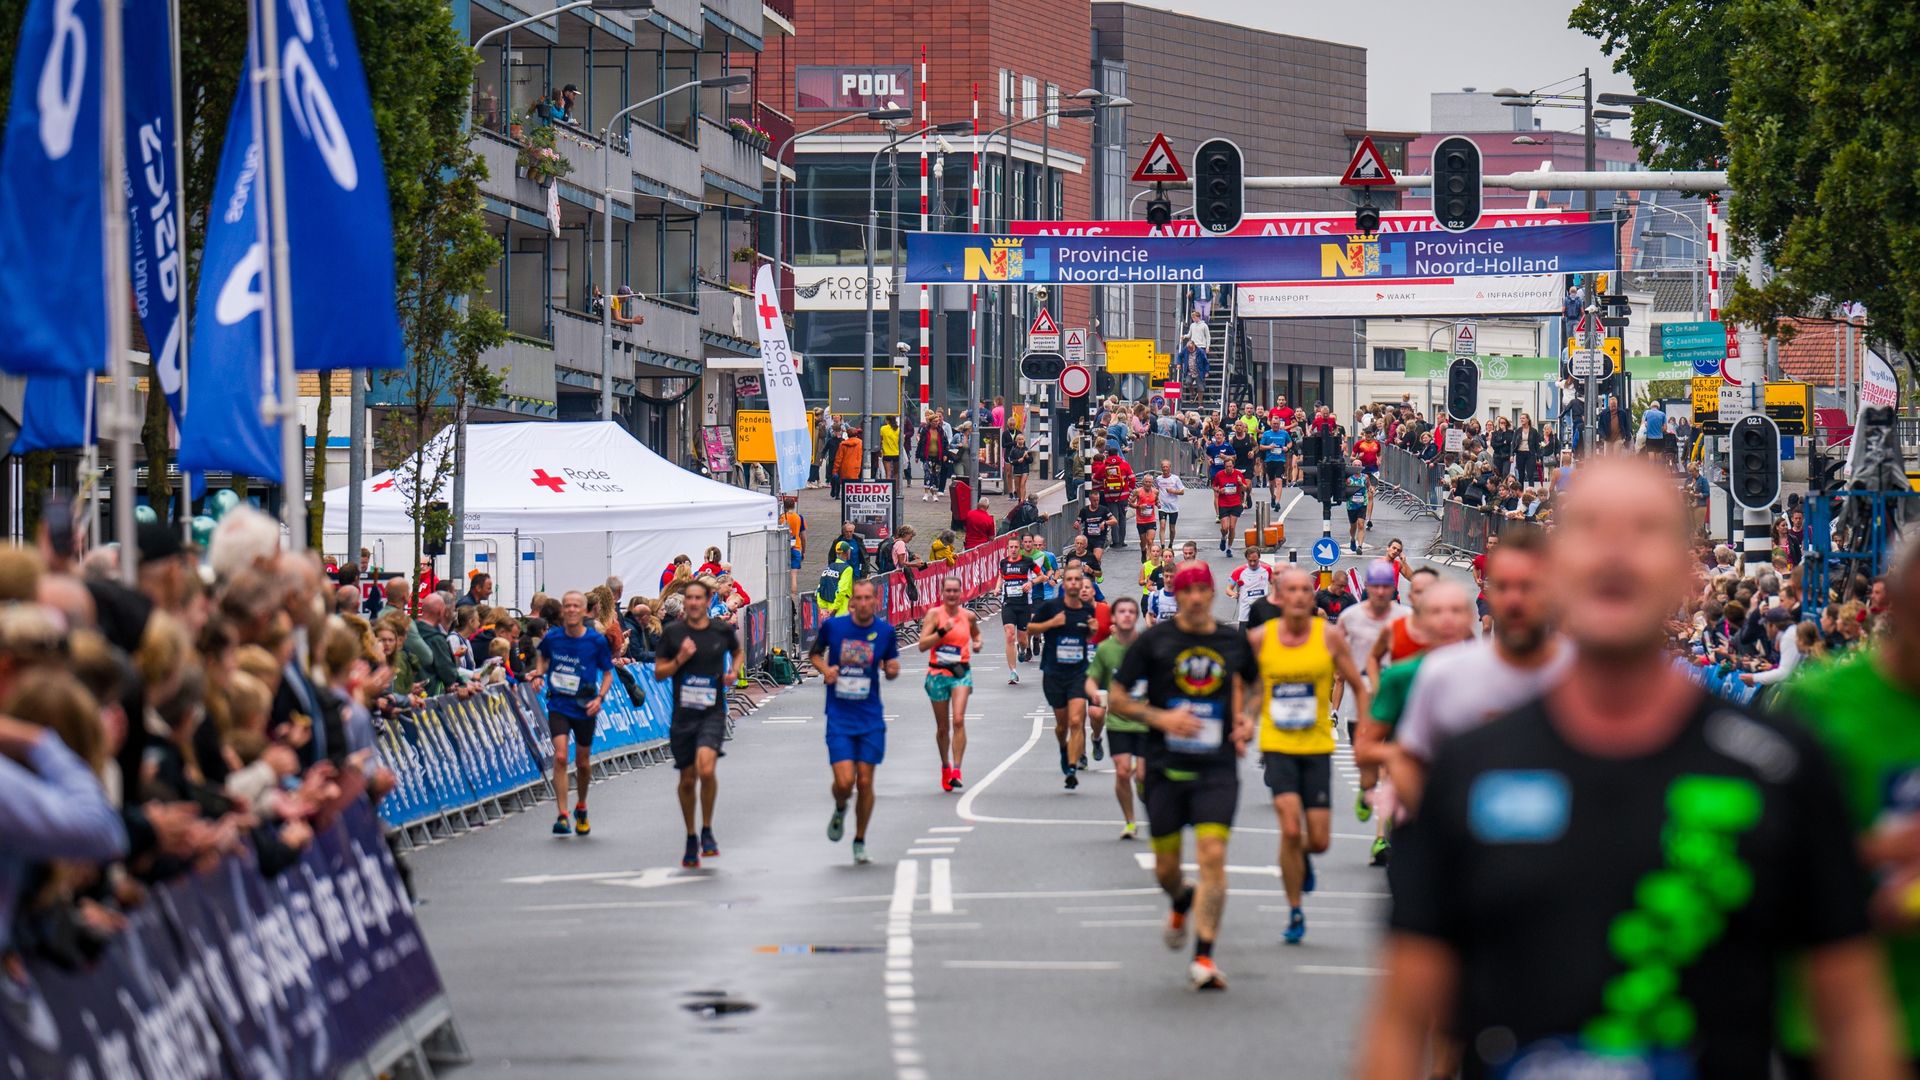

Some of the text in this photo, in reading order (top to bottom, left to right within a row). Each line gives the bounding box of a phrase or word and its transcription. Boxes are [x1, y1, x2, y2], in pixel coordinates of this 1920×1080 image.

[842, 74, 904, 95] POOL
[1211, 223, 1227, 231] 03.1
[1448, 220, 1465, 229] 02.2
[1415, 238, 1504, 256] Provincie
[1059, 247, 1149, 263] Provincie
[1415, 255, 1559, 275] Noord-Holland
[1059, 264, 1204, 281] Noord-Holland
[830, 290, 892, 300] KITCEN
[1259, 290, 1553, 303] TRANSPORT WAAKT INFRASUPPORT
[762, 339, 777, 388] Kruis
[772, 339, 793, 387] Rode
[1721, 390, 1733, 398] na
[739, 415, 772, 424] Pendelb
[1747, 417, 1763, 425] 02.1
[563, 467, 611, 480] Rode
[577, 481, 624, 493] Kruis
[845, 484, 889, 494] REDDY
[845, 494, 891, 503] KEUKENS
[464, 522, 481, 530] Kruis
